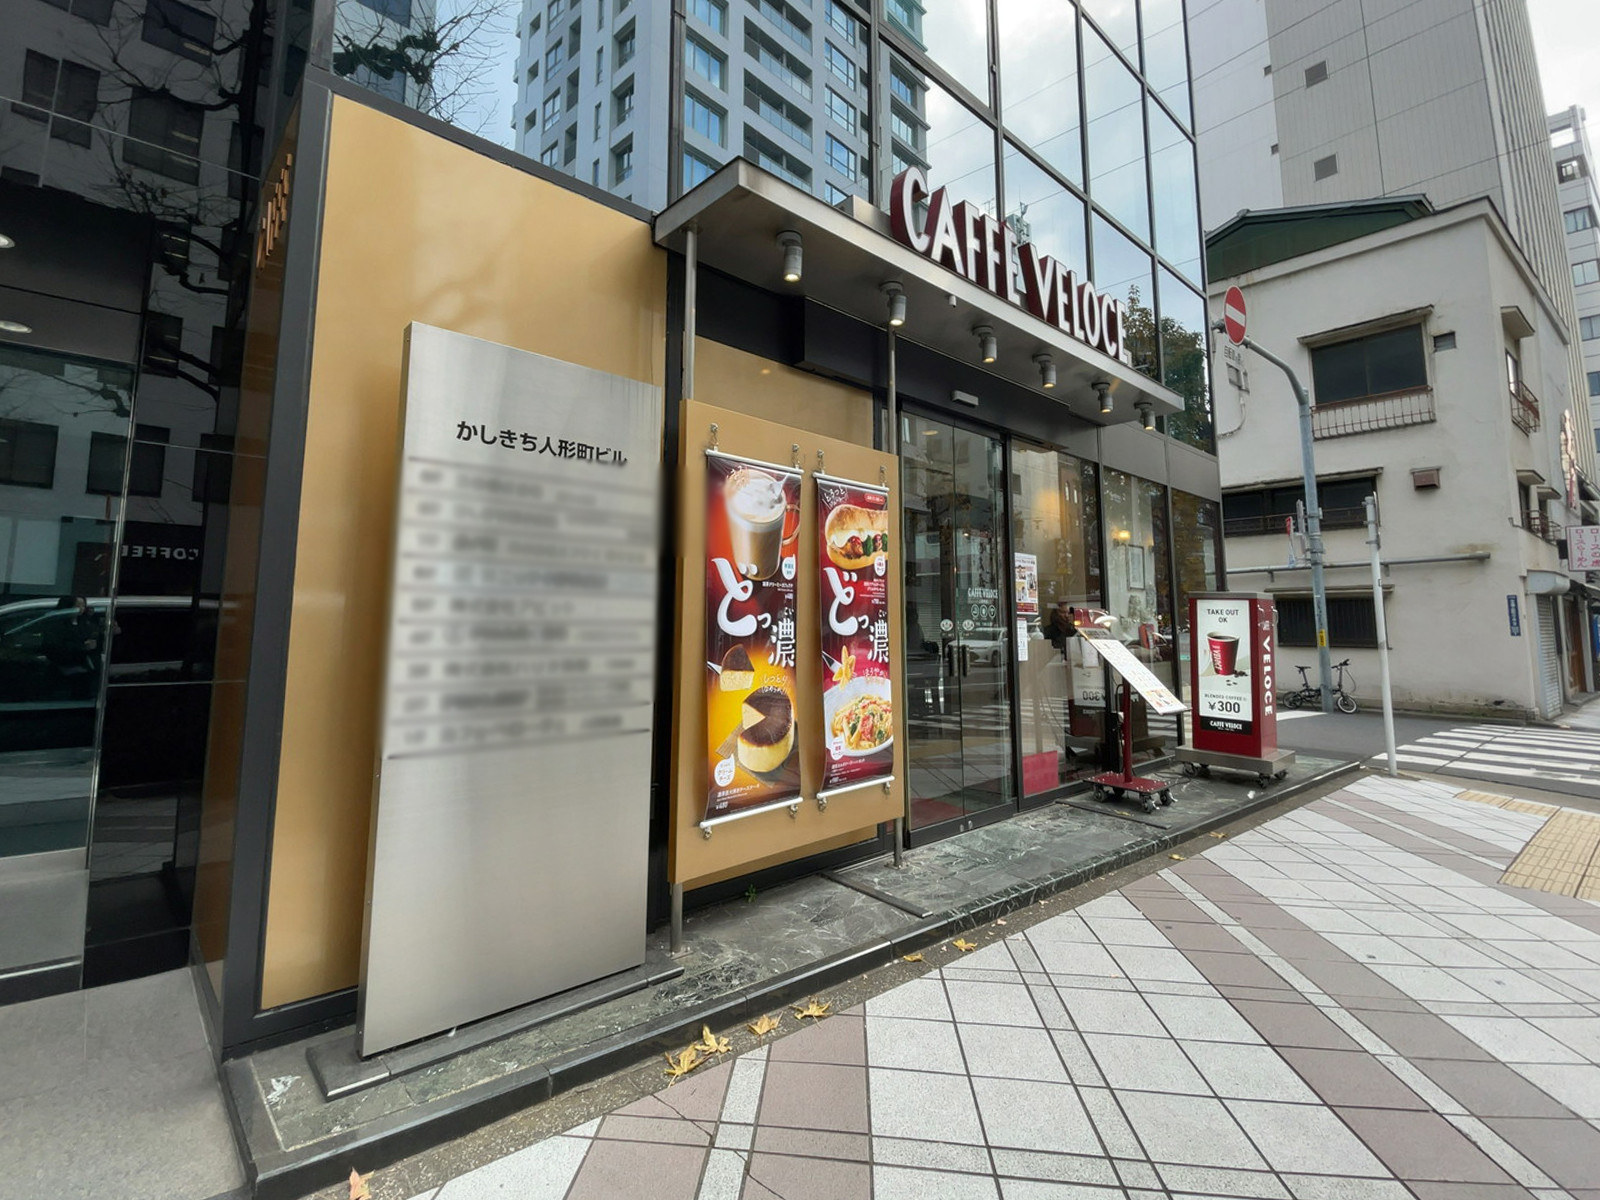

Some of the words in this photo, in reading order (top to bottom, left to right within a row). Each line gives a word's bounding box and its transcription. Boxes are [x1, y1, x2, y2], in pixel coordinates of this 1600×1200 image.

[1020, 242, 1129, 365] VELOCE
[456, 420, 628, 467] かしきち人形町ビル
[1207, 608, 1224, 616] TAKE
[1262, 635, 1273, 716] VELOCE
[1208, 700, 1241, 714] ¥300
